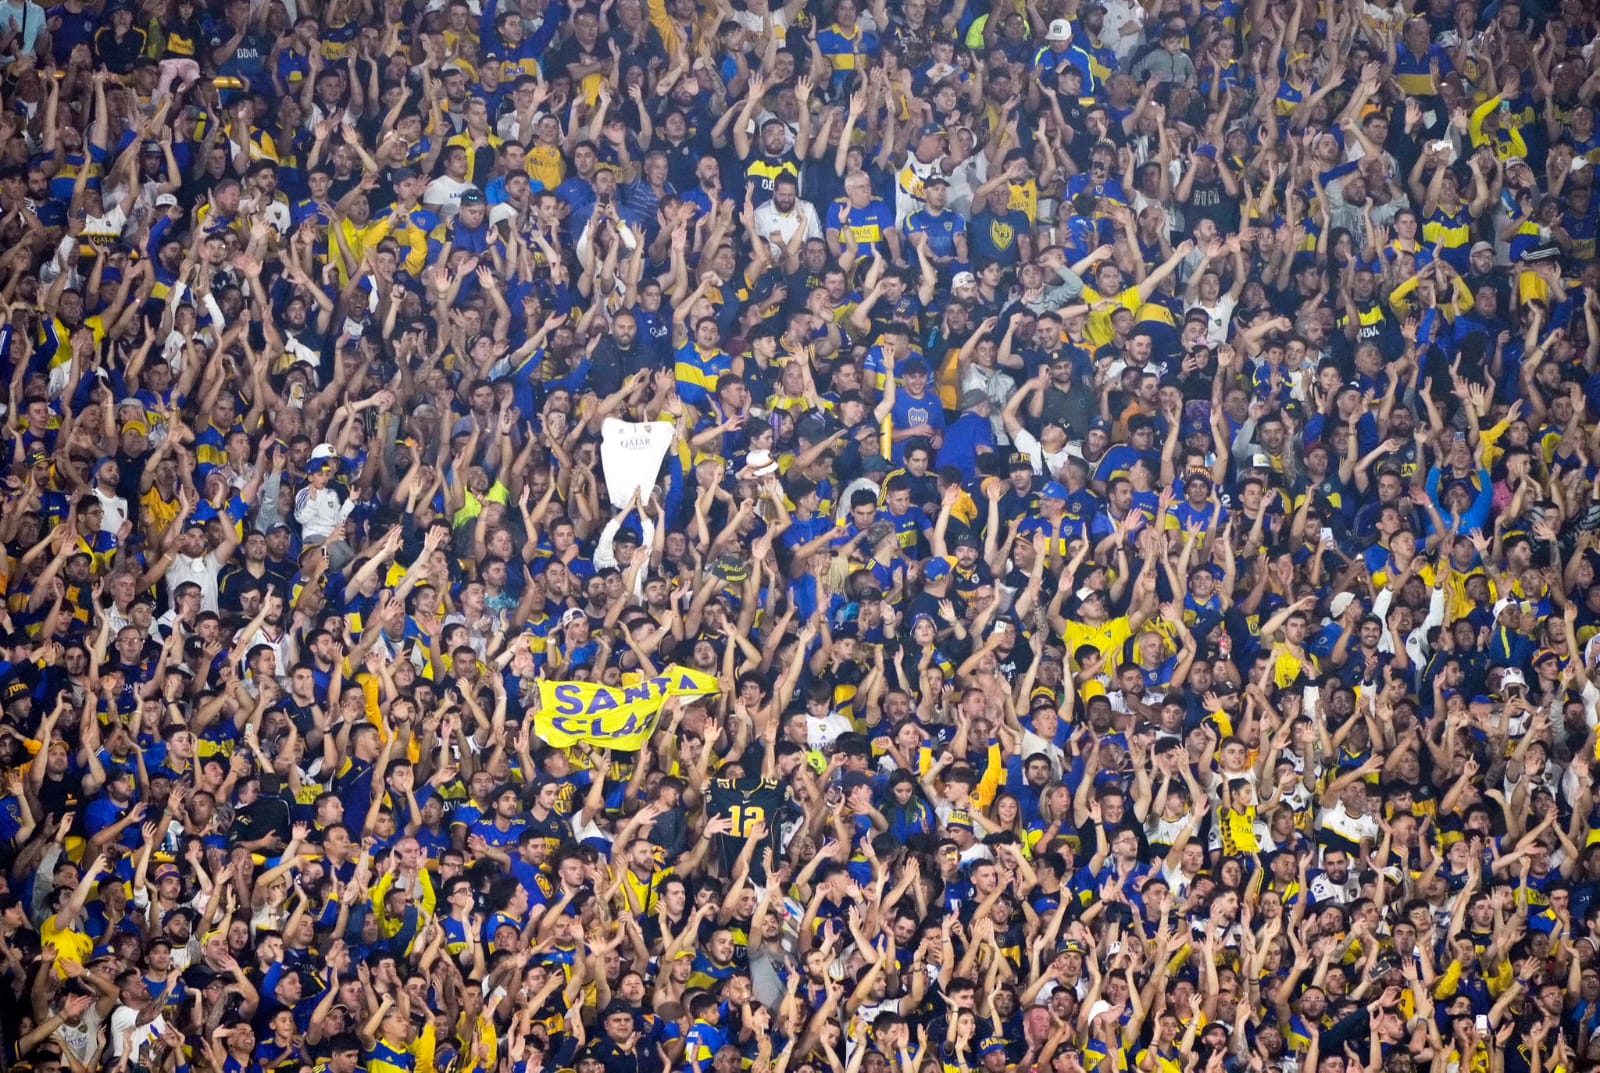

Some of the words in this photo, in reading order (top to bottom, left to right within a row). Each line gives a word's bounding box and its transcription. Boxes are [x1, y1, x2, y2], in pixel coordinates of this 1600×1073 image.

[621, 438, 651, 449] QATAR
[555, 675, 698, 715] SANTA
[728, 805, 764, 838] 12
